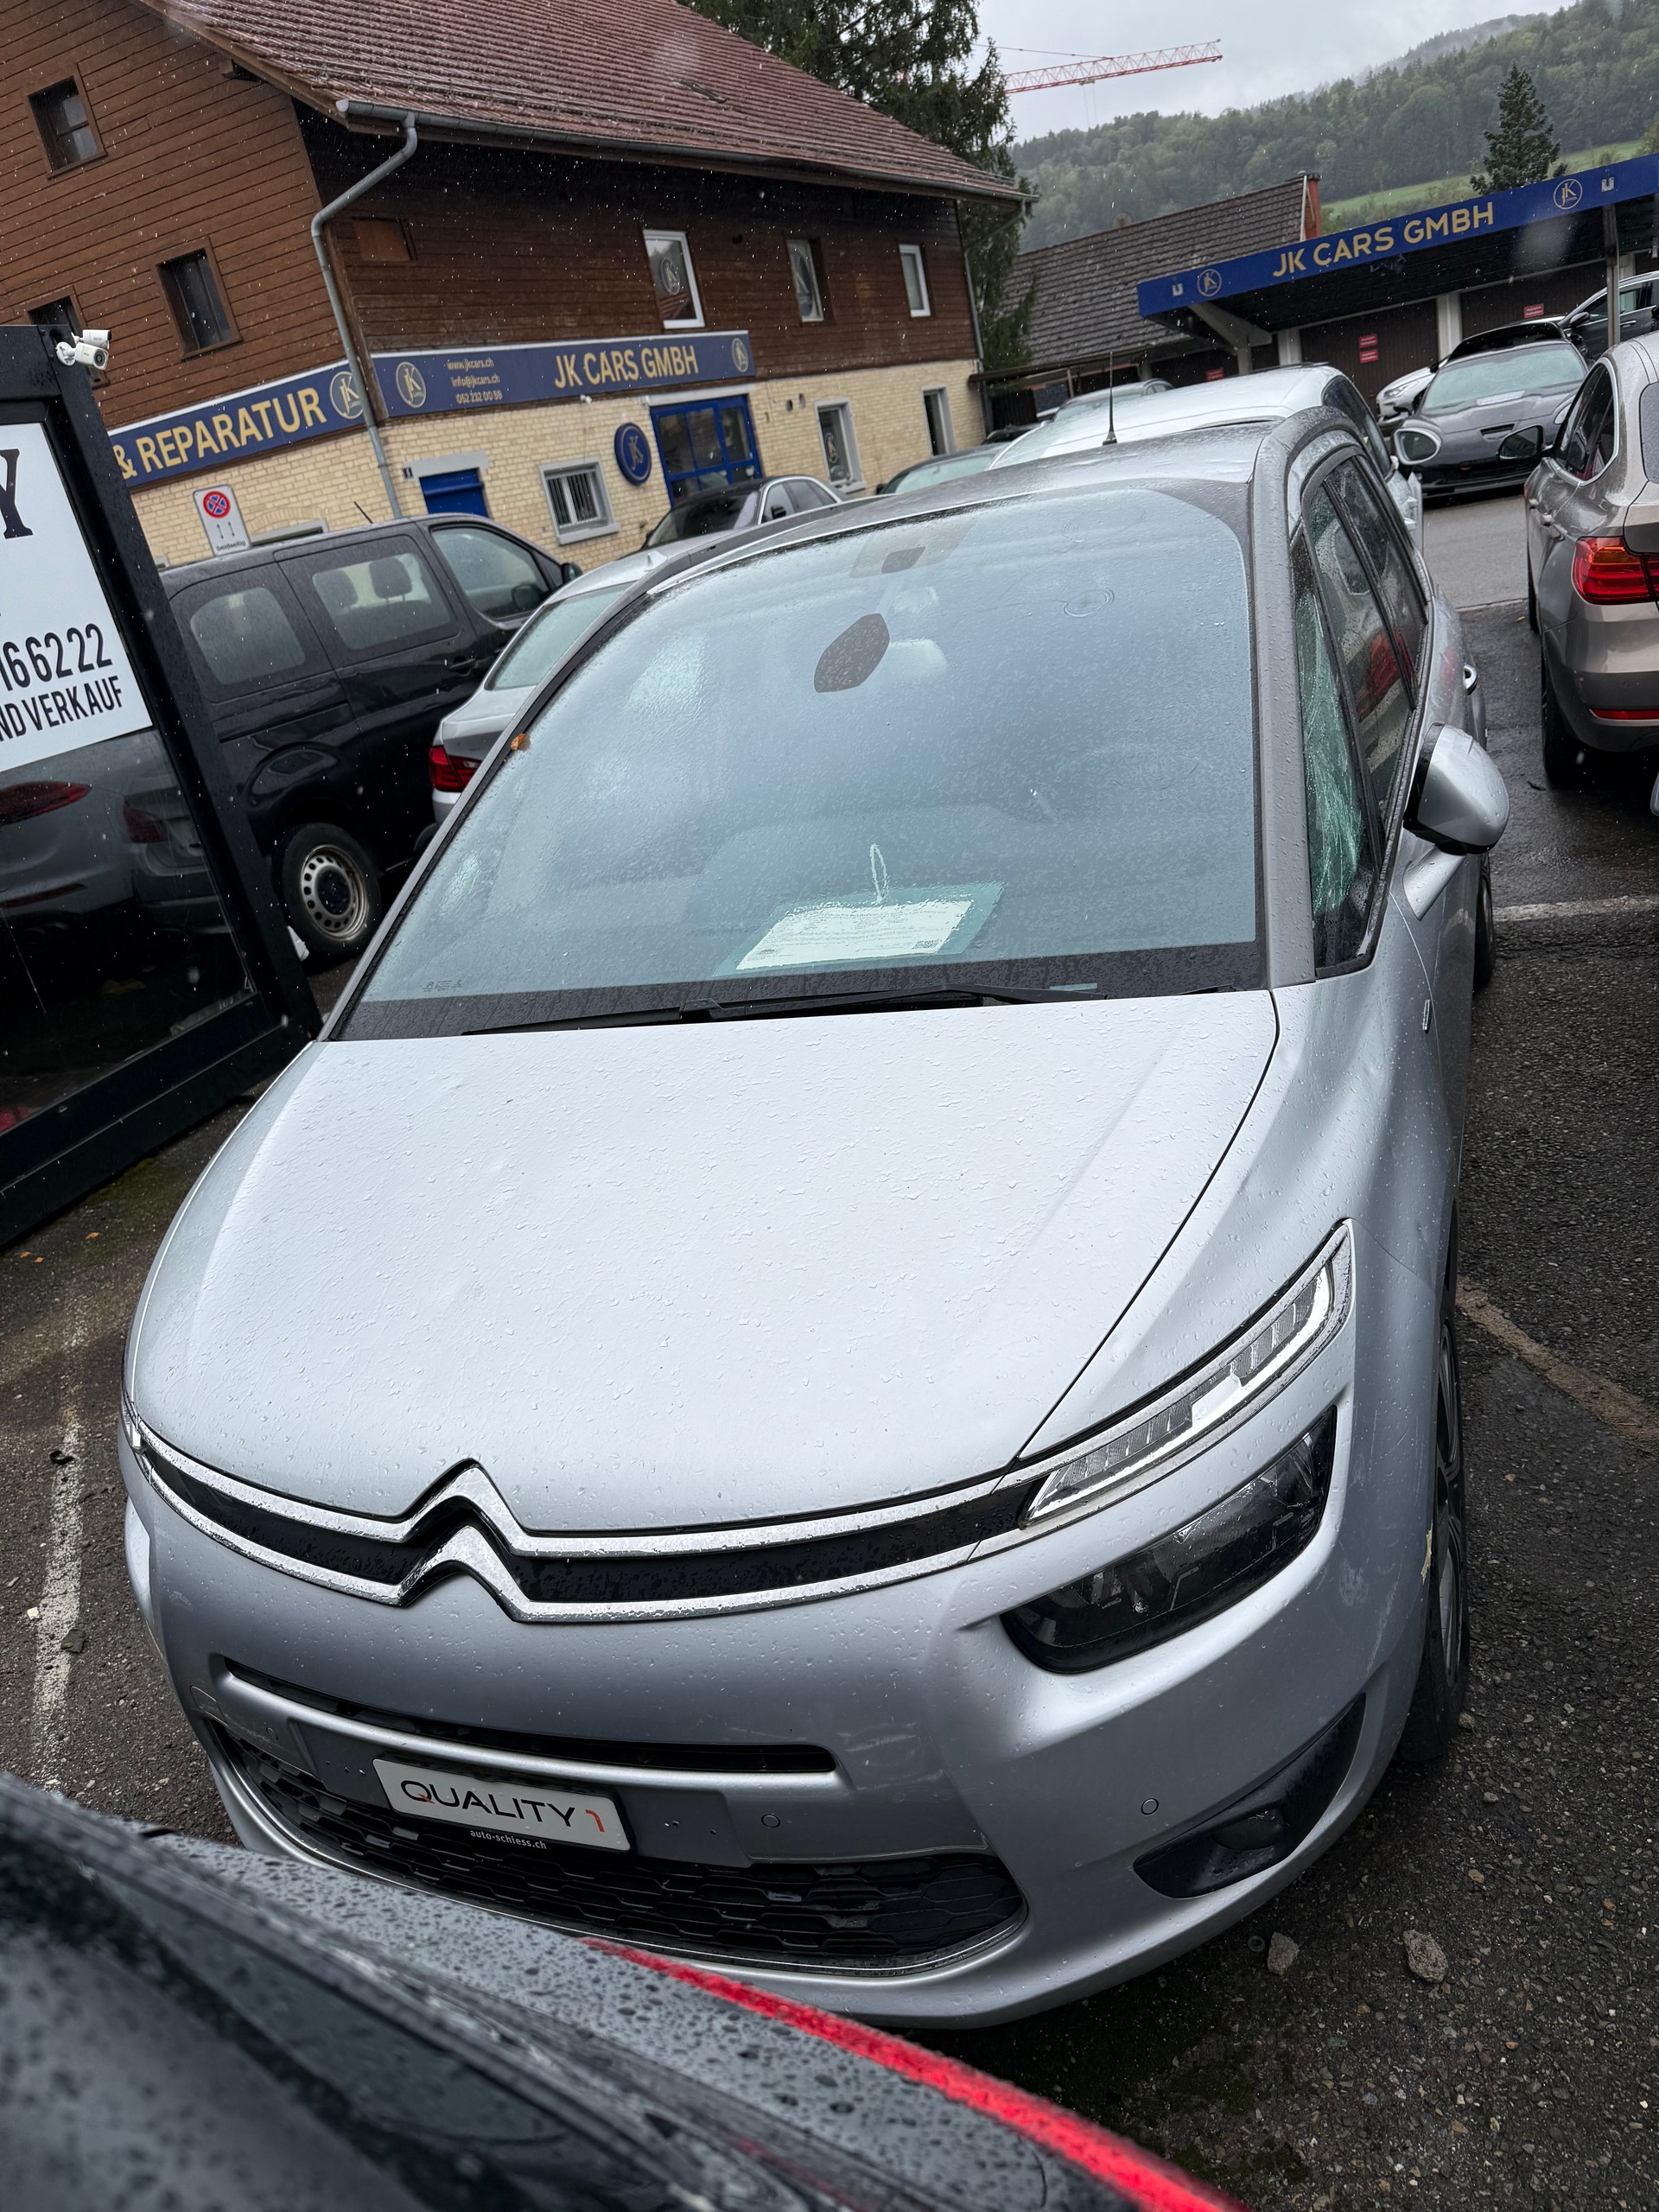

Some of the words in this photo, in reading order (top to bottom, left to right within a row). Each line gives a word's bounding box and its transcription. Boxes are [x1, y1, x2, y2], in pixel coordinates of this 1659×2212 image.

[1273, 248, 1306, 277] JK
[1313, 226, 1395, 266] CARS
[1403, 201, 1494, 244] GMBH
[554, 353, 583, 389] JK
[583, 349, 639, 385] CARS
[640, 345, 699, 378] GMBH
[136, 387, 327, 474] REPARATUR
[22, 675, 123, 731] VERKAUF
[400, 1780, 575, 1827] QUALITY
[469, 1830, 547, 1850] auto-schiess.ch
